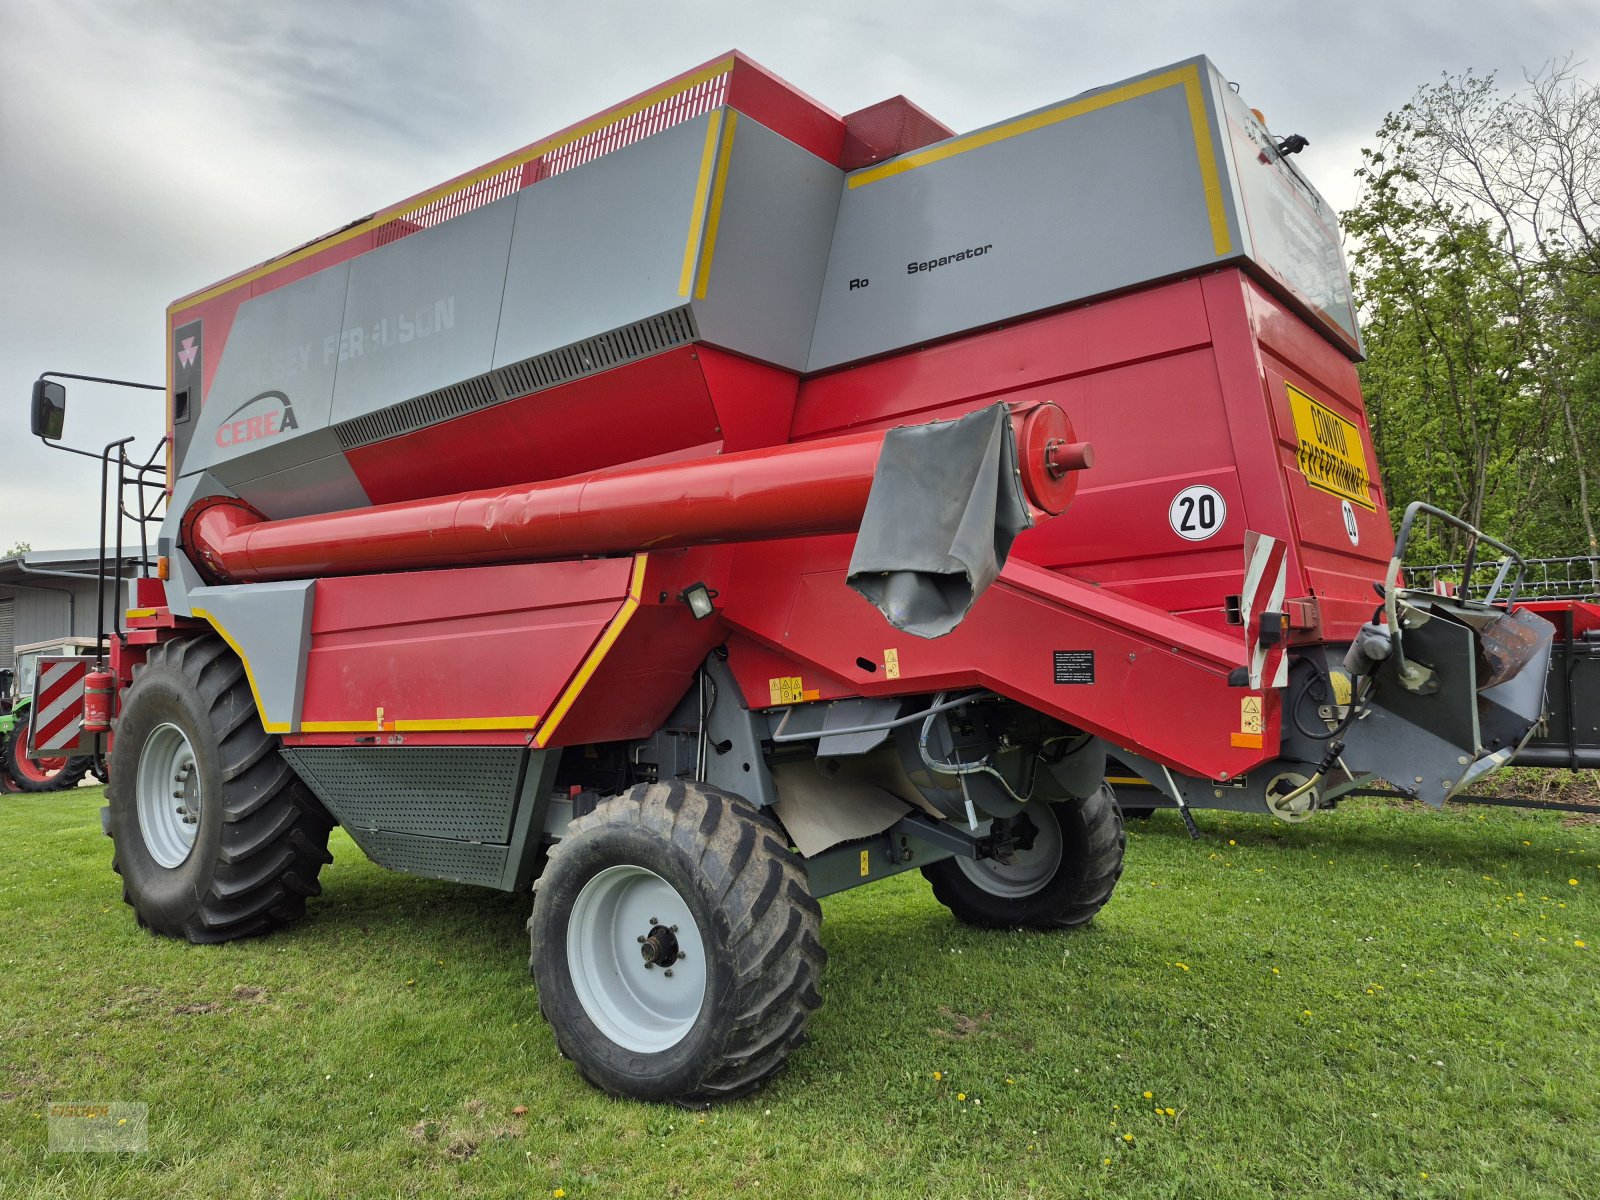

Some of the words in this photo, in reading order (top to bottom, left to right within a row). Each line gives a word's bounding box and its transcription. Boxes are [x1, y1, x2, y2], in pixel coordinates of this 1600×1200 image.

[849, 278, 870, 292] Ro
[907, 244, 993, 275] Separator
[215, 404, 299, 450] CEREA
[1311, 404, 1349, 458] CONVOI
[1179, 494, 1216, 532] 20
[1344, 506, 1357, 538] 20
